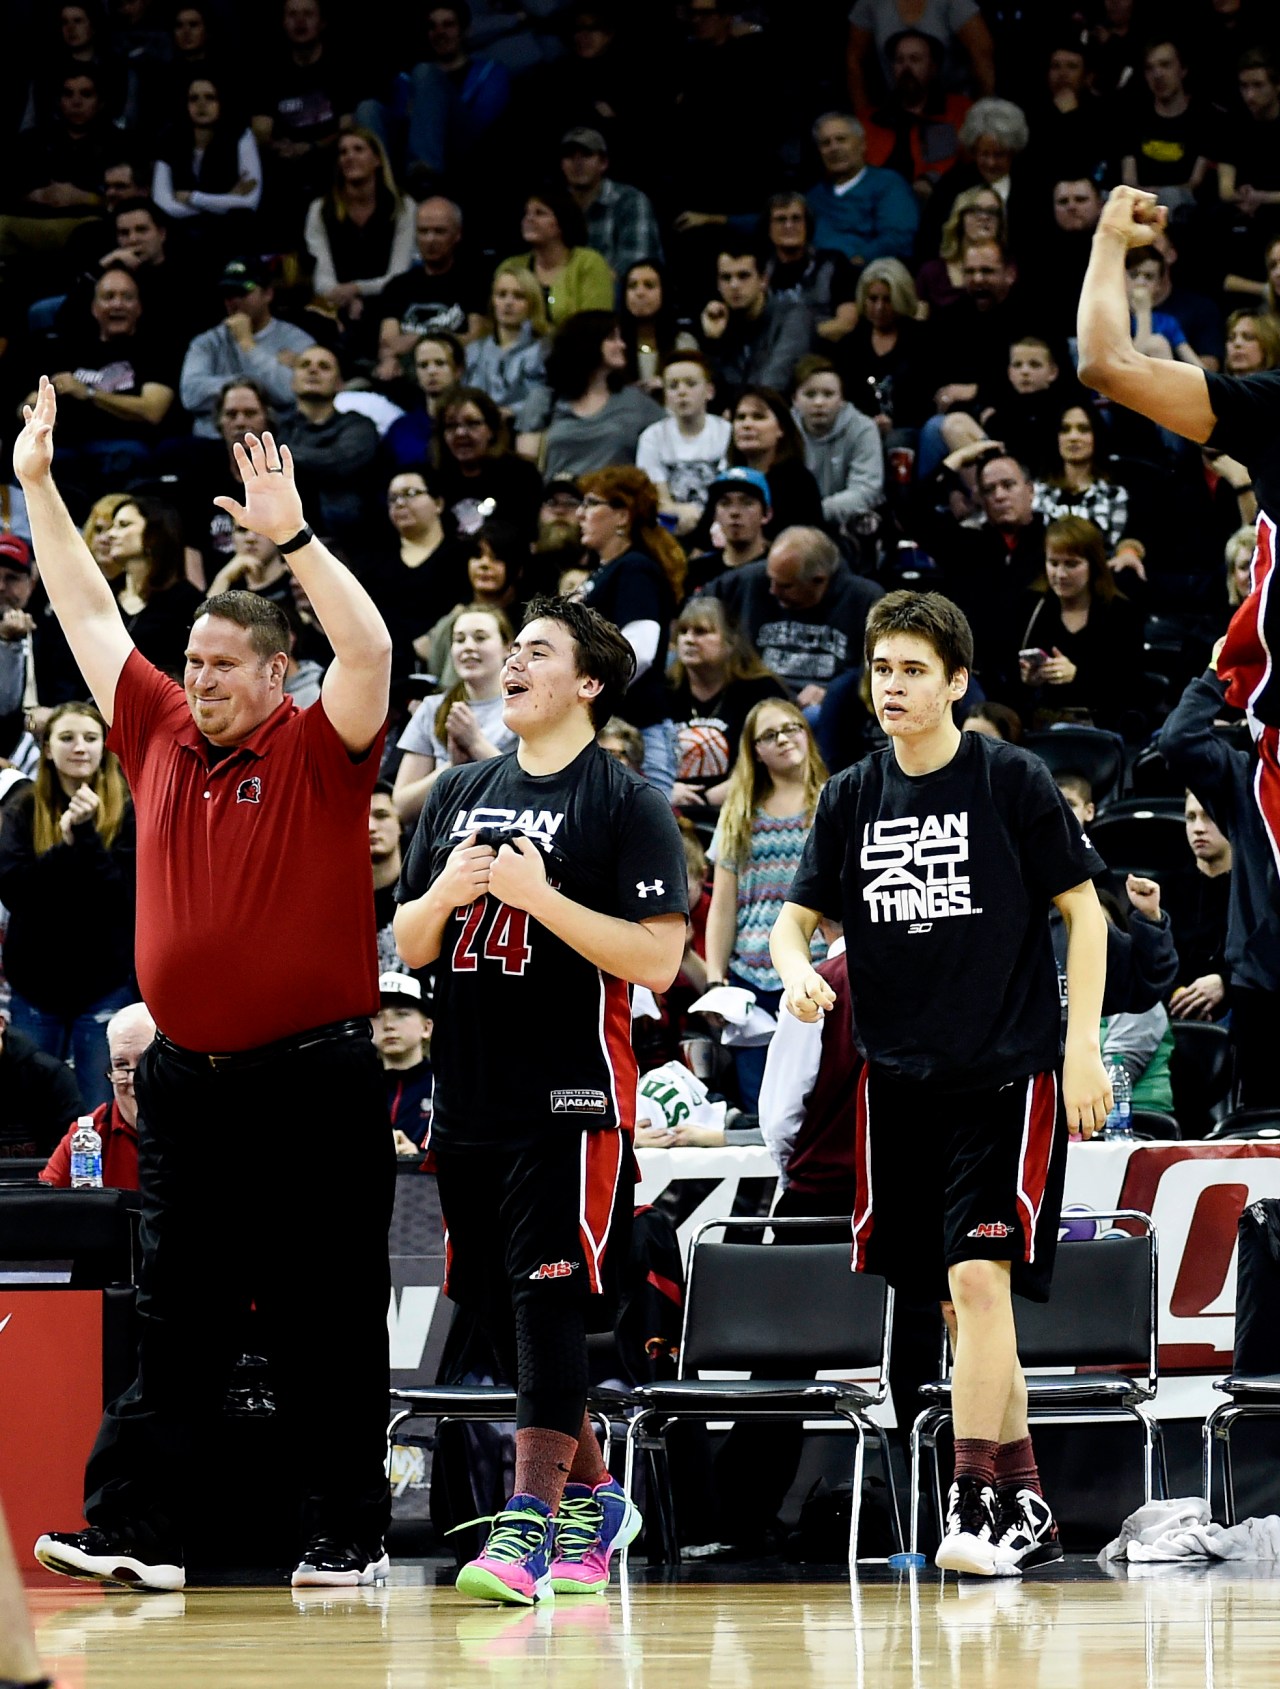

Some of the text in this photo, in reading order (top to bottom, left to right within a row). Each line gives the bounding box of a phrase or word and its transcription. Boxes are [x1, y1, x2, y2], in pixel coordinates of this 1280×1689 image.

[452, 807, 565, 835] I CAN
[862, 811, 969, 847] I CAN
[860, 836, 969, 870] DO
[862, 861, 970, 901] ALL
[452, 895, 533, 976] 24
[972, 1221, 1010, 1238] NB
[535, 1260, 575, 1280] NB
